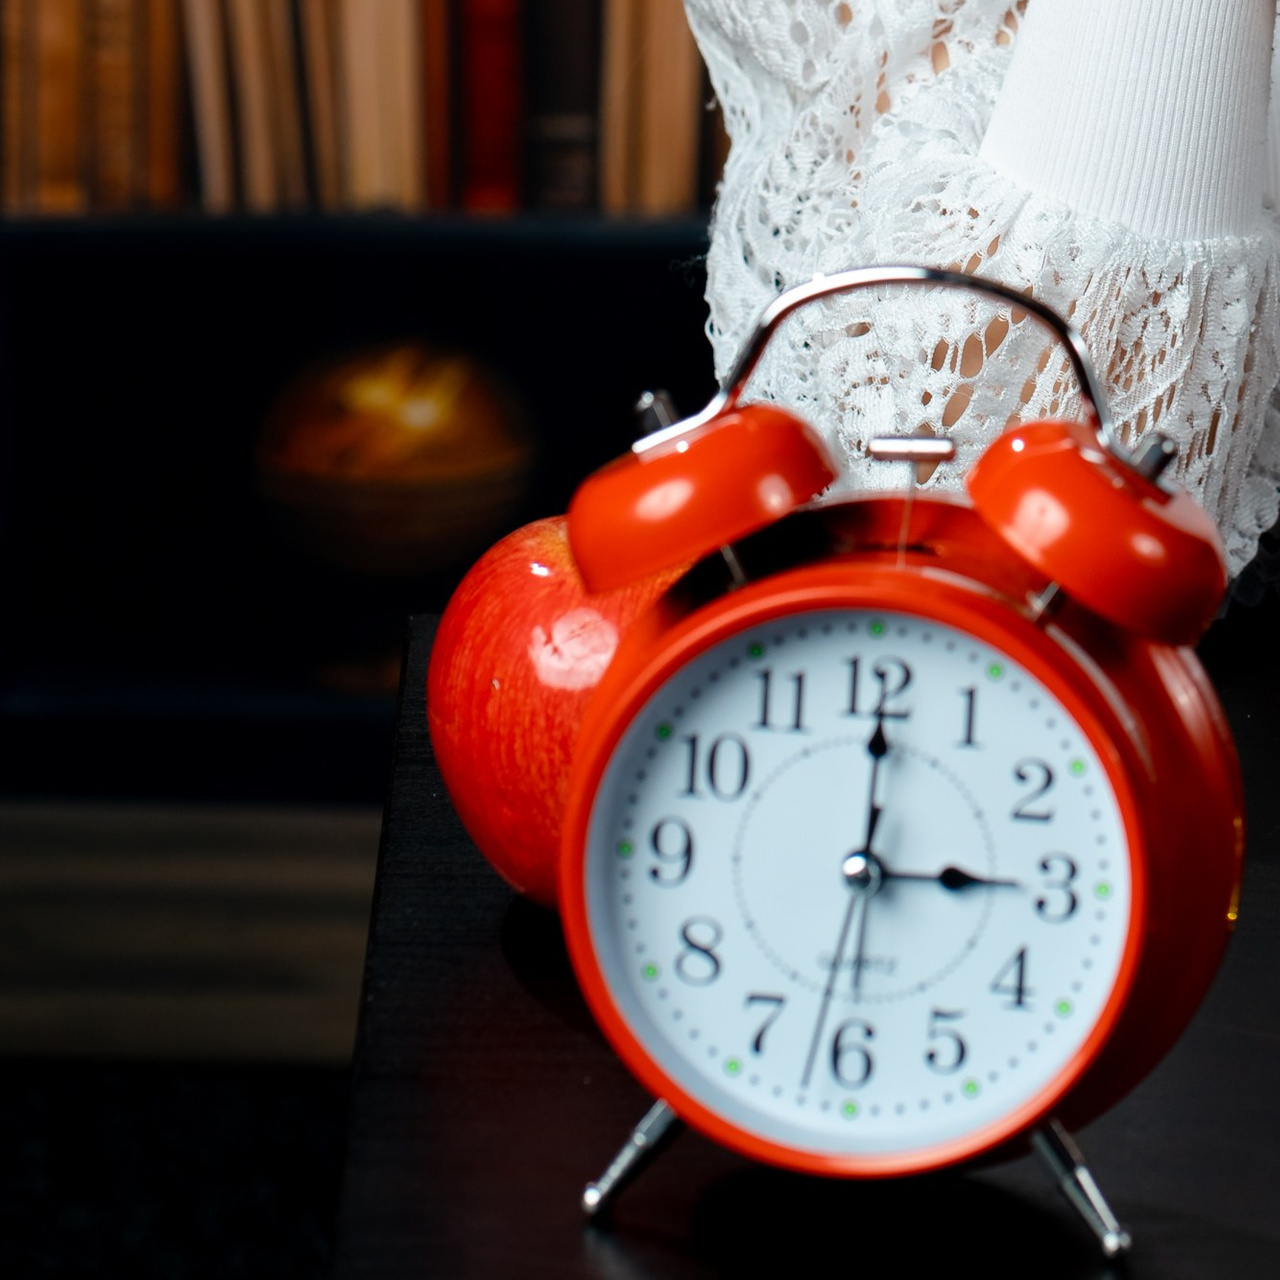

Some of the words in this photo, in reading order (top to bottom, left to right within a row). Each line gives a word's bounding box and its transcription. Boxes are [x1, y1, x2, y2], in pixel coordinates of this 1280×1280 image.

[751, 667, 809, 734] 11
[841, 654, 913, 719] 12
[957, 684, 984, 751] 1
[677, 734, 751, 803] 10
[1011, 757, 1056, 823] 2
[649, 815, 694, 889] 9
[1034, 852, 1079, 924] 3
[673, 915, 723, 987] 8
[990, 945, 1035, 1011] 4
[744, 993, 787, 1056] 7
[829, 1018, 876, 1090] 6
[924, 1008, 968, 1075] 5
